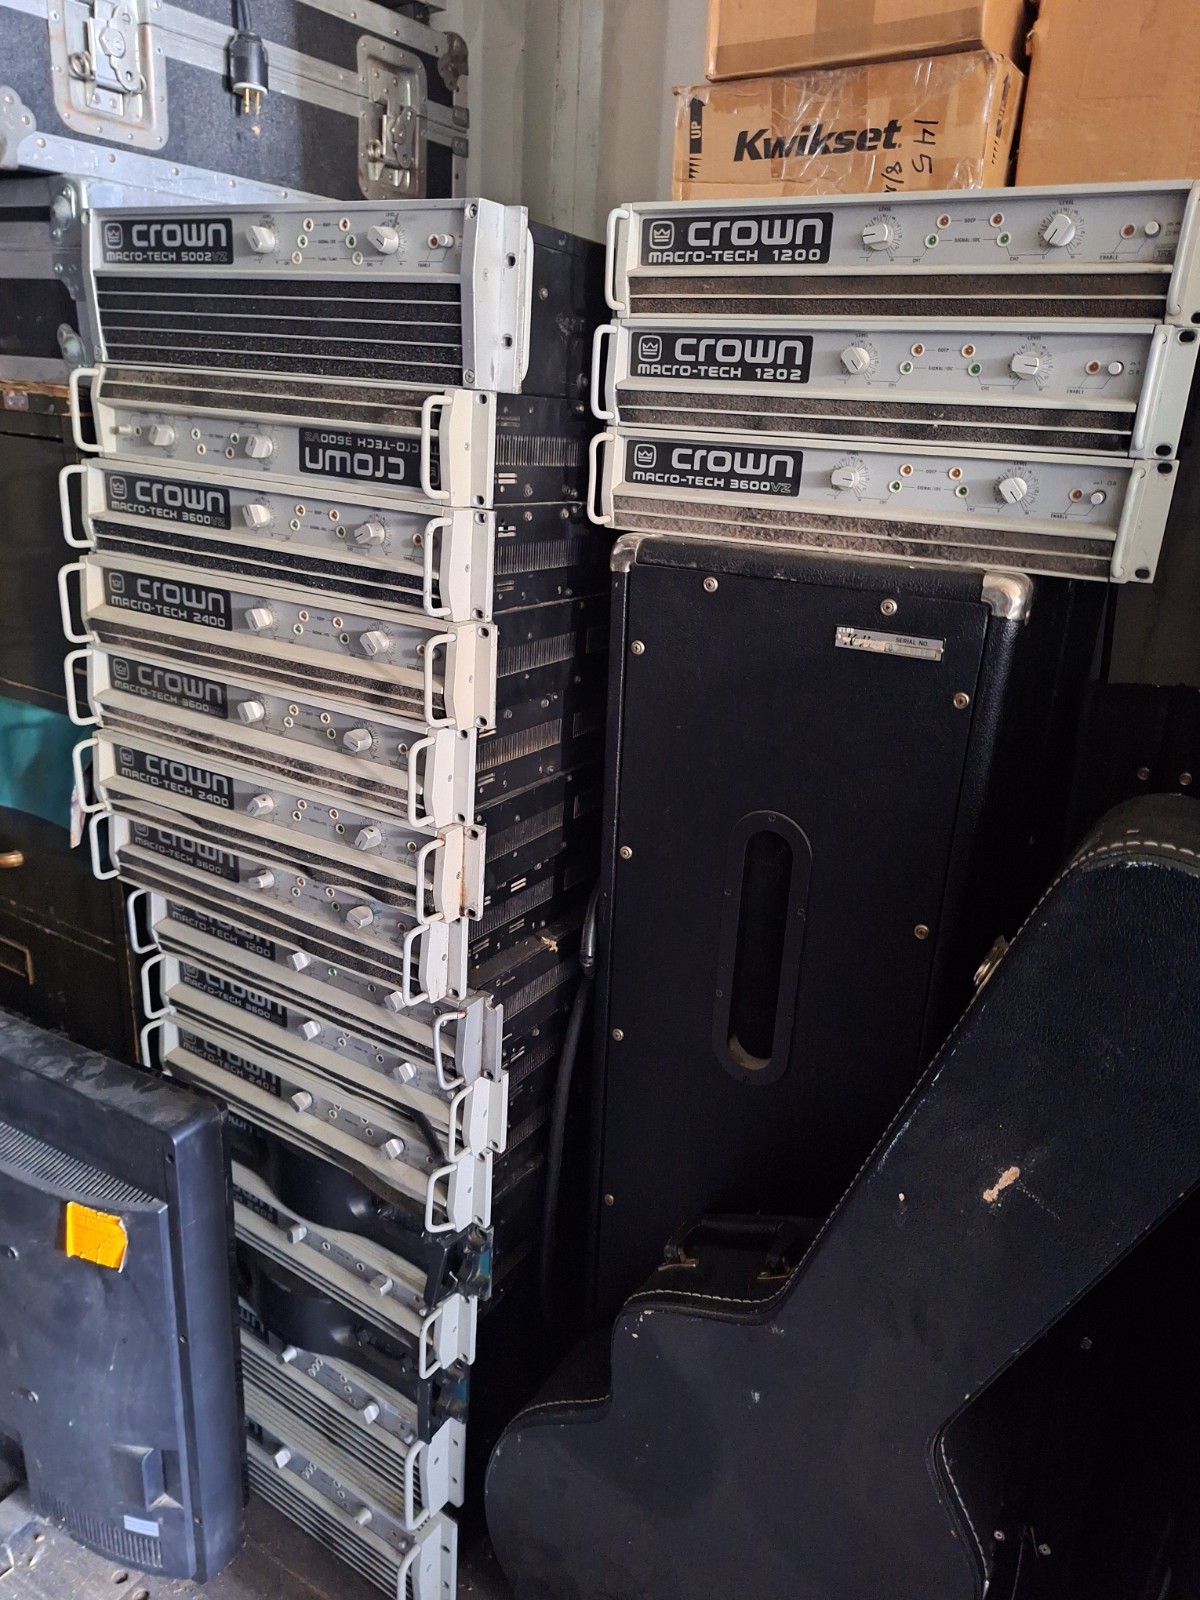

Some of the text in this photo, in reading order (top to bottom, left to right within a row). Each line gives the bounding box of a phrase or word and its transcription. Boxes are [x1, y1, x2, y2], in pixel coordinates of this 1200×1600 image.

[690, 121, 702, 139] UP
[733, 119, 902, 162] Kwikset
[131, 222, 227, 247] crown
[687, 218, 824, 247] crown
[106, 251, 177, 262] MACRO-TECH
[648, 248, 821, 263] MACRO-TECH 1200
[674, 337, 804, 365] crown
[637, 363, 802, 381] MACRO-TECH 1202
[671, 447, 794, 478] crown
[633, 471, 792, 494] MACRO-TECH 3600VZ
[111, 500, 178, 519] MACRO-TECH
[135, 480, 225, 514] crown
[136, 578, 225, 614] crown
[111, 595, 226, 628] MACRO-TECH 2400
[895, 637, 917, 646] SERIAL
[114, 680, 178, 704] MACRO-TECH
[137, 665, 223, 704] crown
[121, 767, 230, 807] MACRO-TECH 2400
[145, 755, 229, 795] crown
[244, 940, 271, 957] 1200
